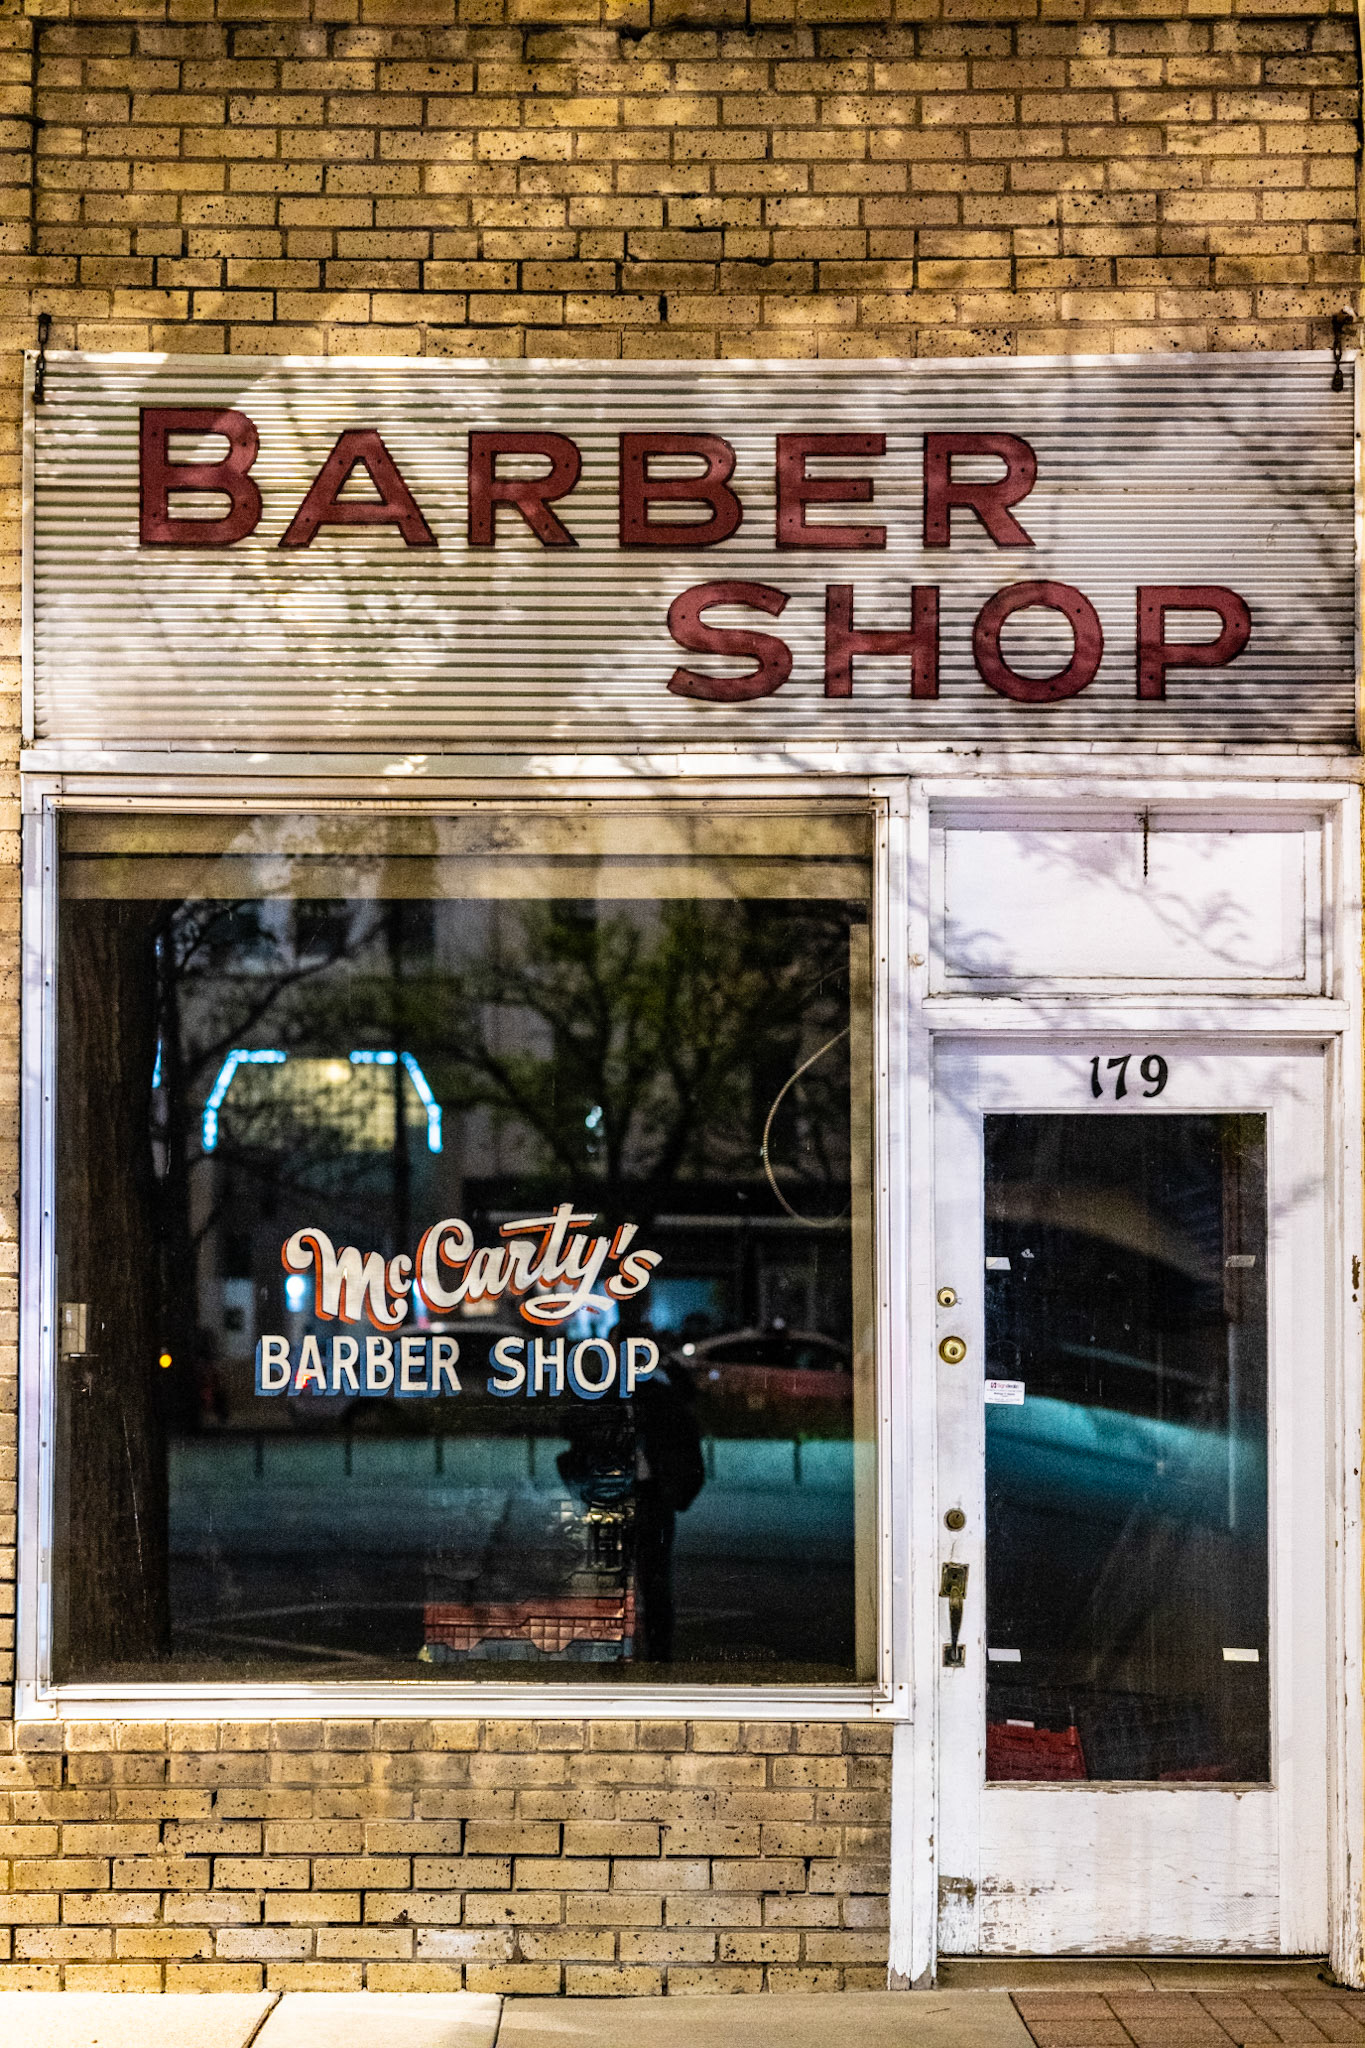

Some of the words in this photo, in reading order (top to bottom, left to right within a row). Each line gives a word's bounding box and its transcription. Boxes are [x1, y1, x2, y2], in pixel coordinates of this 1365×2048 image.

[139, 406, 1038, 548] BARBER
[666, 580, 1252, 702] SHOP
[1090, 1054, 1168, 1100] 179
[282, 1203, 662, 1331] McCarty's
[256, 1335, 462, 1396] BARBER
[488, 1336, 660, 1398] SHOP
